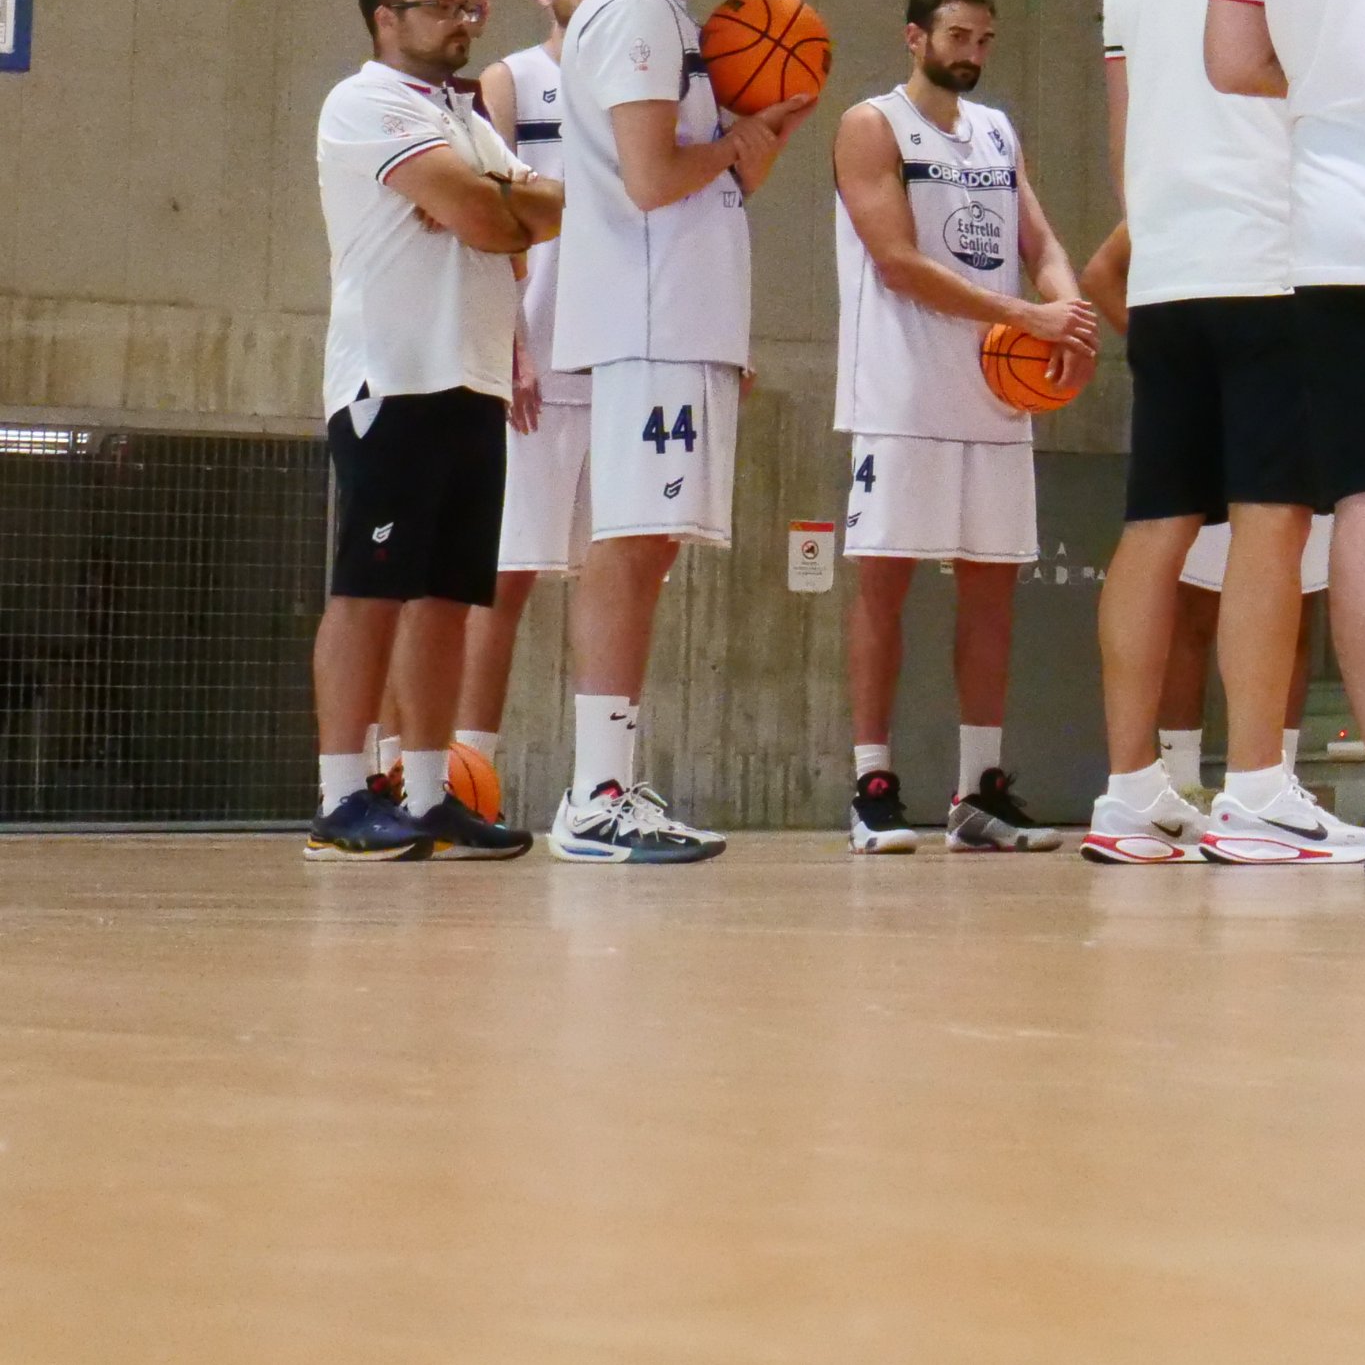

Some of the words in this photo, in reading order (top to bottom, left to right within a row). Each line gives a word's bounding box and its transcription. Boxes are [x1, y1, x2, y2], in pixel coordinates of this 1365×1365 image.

[928, 165, 1011, 186] OBRADOIRO
[957, 218, 1000, 238] Estrella
[959, 234, 999, 254] Galicia
[642, 404, 697, 454] 44
